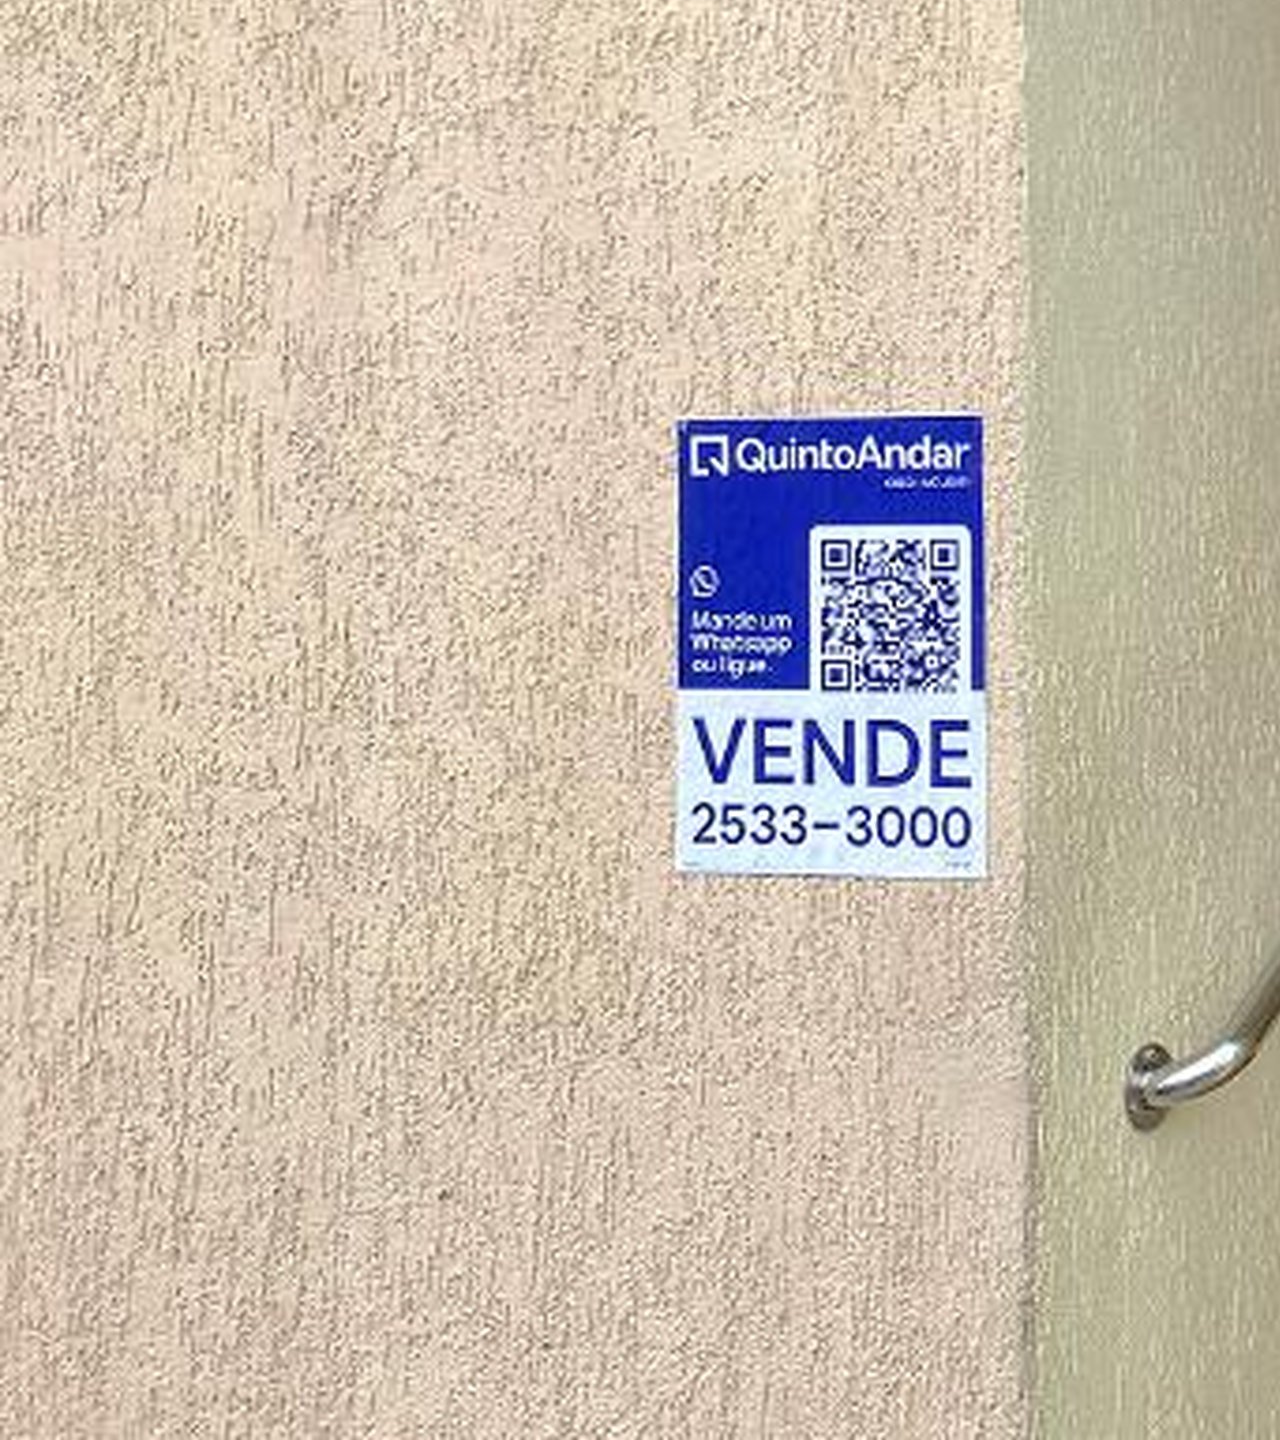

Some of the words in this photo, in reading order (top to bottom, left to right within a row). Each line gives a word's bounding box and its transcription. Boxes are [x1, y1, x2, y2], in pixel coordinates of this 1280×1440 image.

[736, 434, 971, 473] QuintoAndar
[761, 614, 793, 632] um
[692, 717, 972, 789] VENDE
[692, 801, 972, 849] 2533-3000
